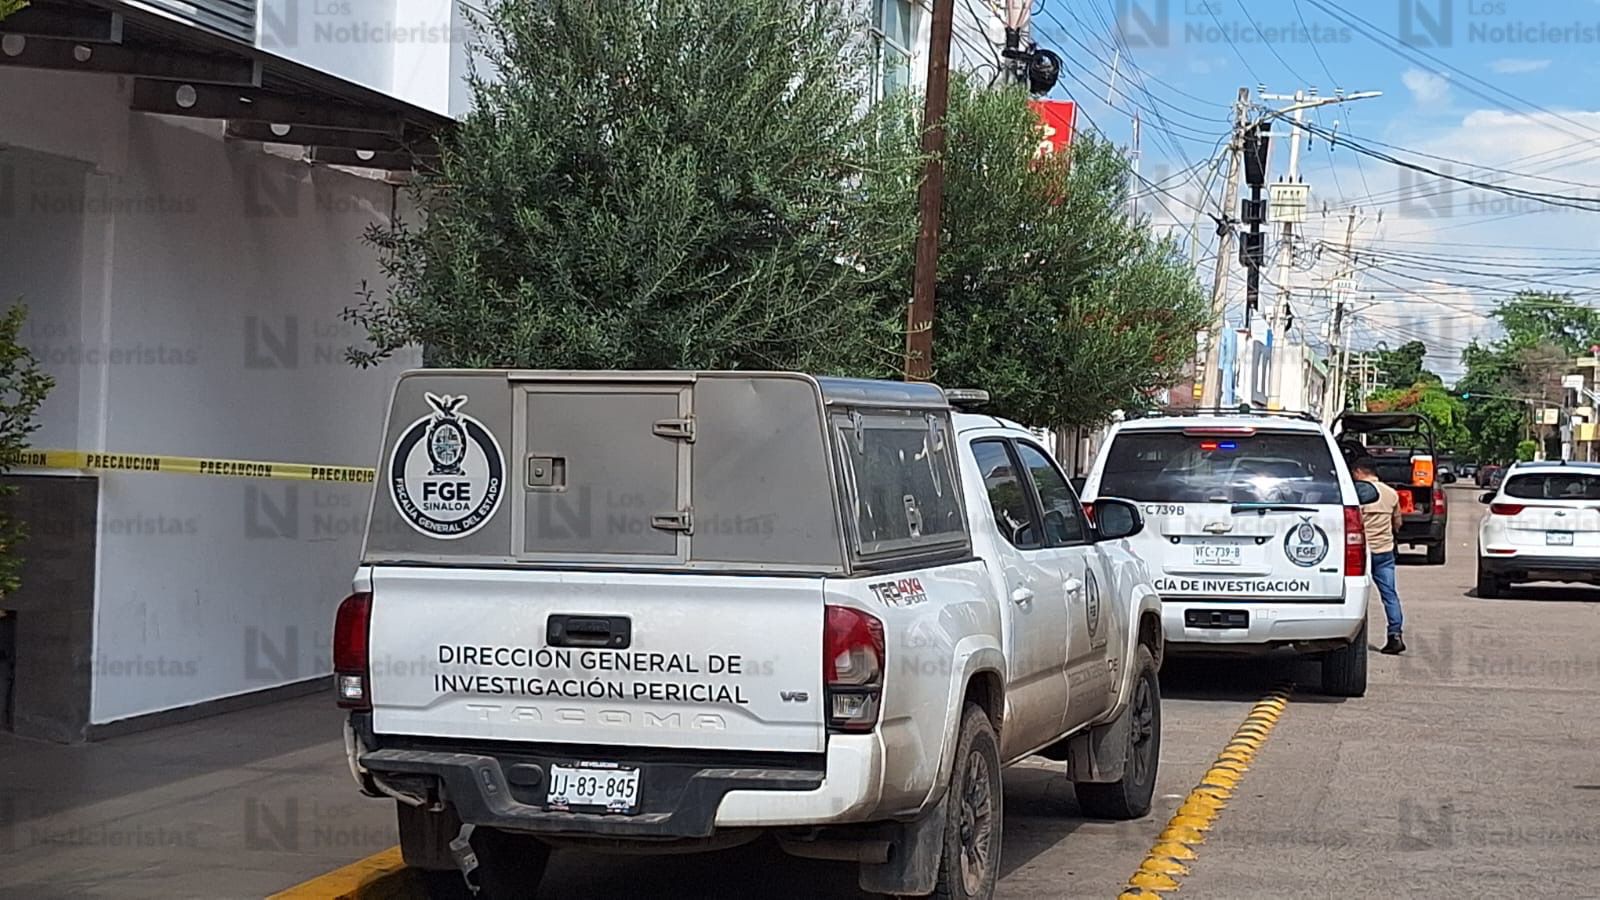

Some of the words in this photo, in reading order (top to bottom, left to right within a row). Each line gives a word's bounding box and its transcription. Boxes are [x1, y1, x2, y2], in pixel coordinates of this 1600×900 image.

[86, 454, 161, 471] PRECAUCION
[200, 460, 272, 478] PRECAUCION
[311, 467, 377, 482] PRECAUCIO
[423, 482, 471, 501] FGE
[419, 517, 461, 532] GENERAL
[463, 515, 481, 529] DEL
[478, 478, 499, 516] ESTADO
[423, 502, 471, 511] SINALOA
[1296, 547, 1317, 555] FGE
[1152, 577, 1177, 591] CÍA
[1181, 580, 1199, 591] DE
[1203, 579, 1310, 592] INVESTIGACIÓN
[439, 645, 571, 668] DIRECCIÓN
[580, 651, 699, 673] GENERAL
[708, 655, 742, 674] DE
[434, 674, 623, 698] INVESTIGACIÓN
[633, 682, 749, 704] PERICIAL
[466, 704, 727, 730] TACOMA
